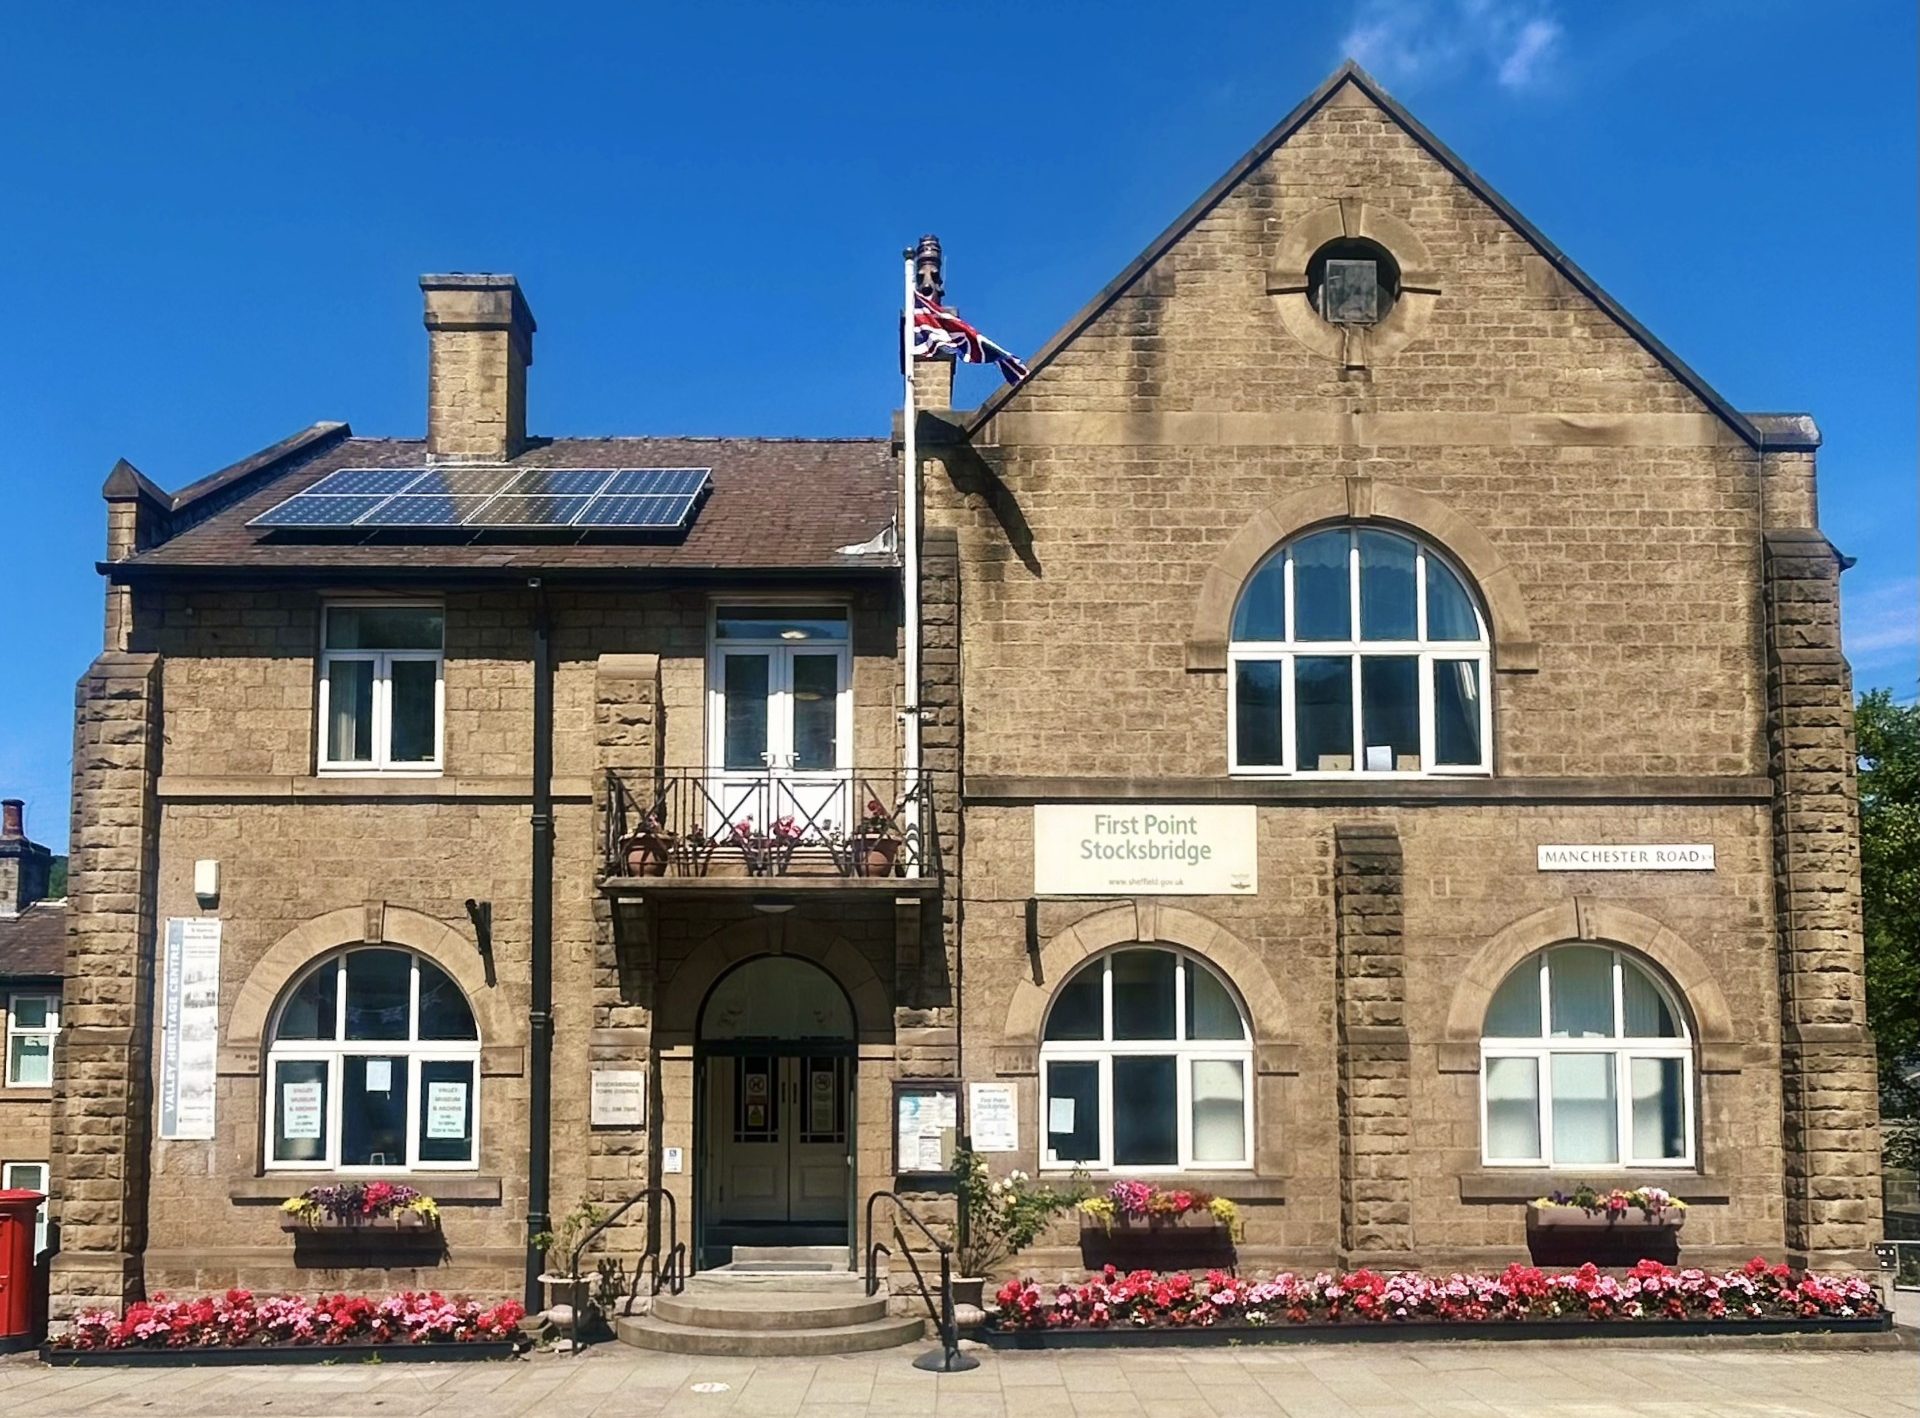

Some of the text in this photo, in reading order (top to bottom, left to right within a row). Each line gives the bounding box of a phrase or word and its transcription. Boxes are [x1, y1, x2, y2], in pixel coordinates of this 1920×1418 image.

[1094, 814, 1198, 835] First Point
[1080, 839, 1212, 866] Stocksbridge
[1545, 850, 1649, 863] MANCHESTER
[1656, 850, 1700, 863] ROAD
[165, 943, 180, 1113] VALLEY HERITAGE CENTRE
